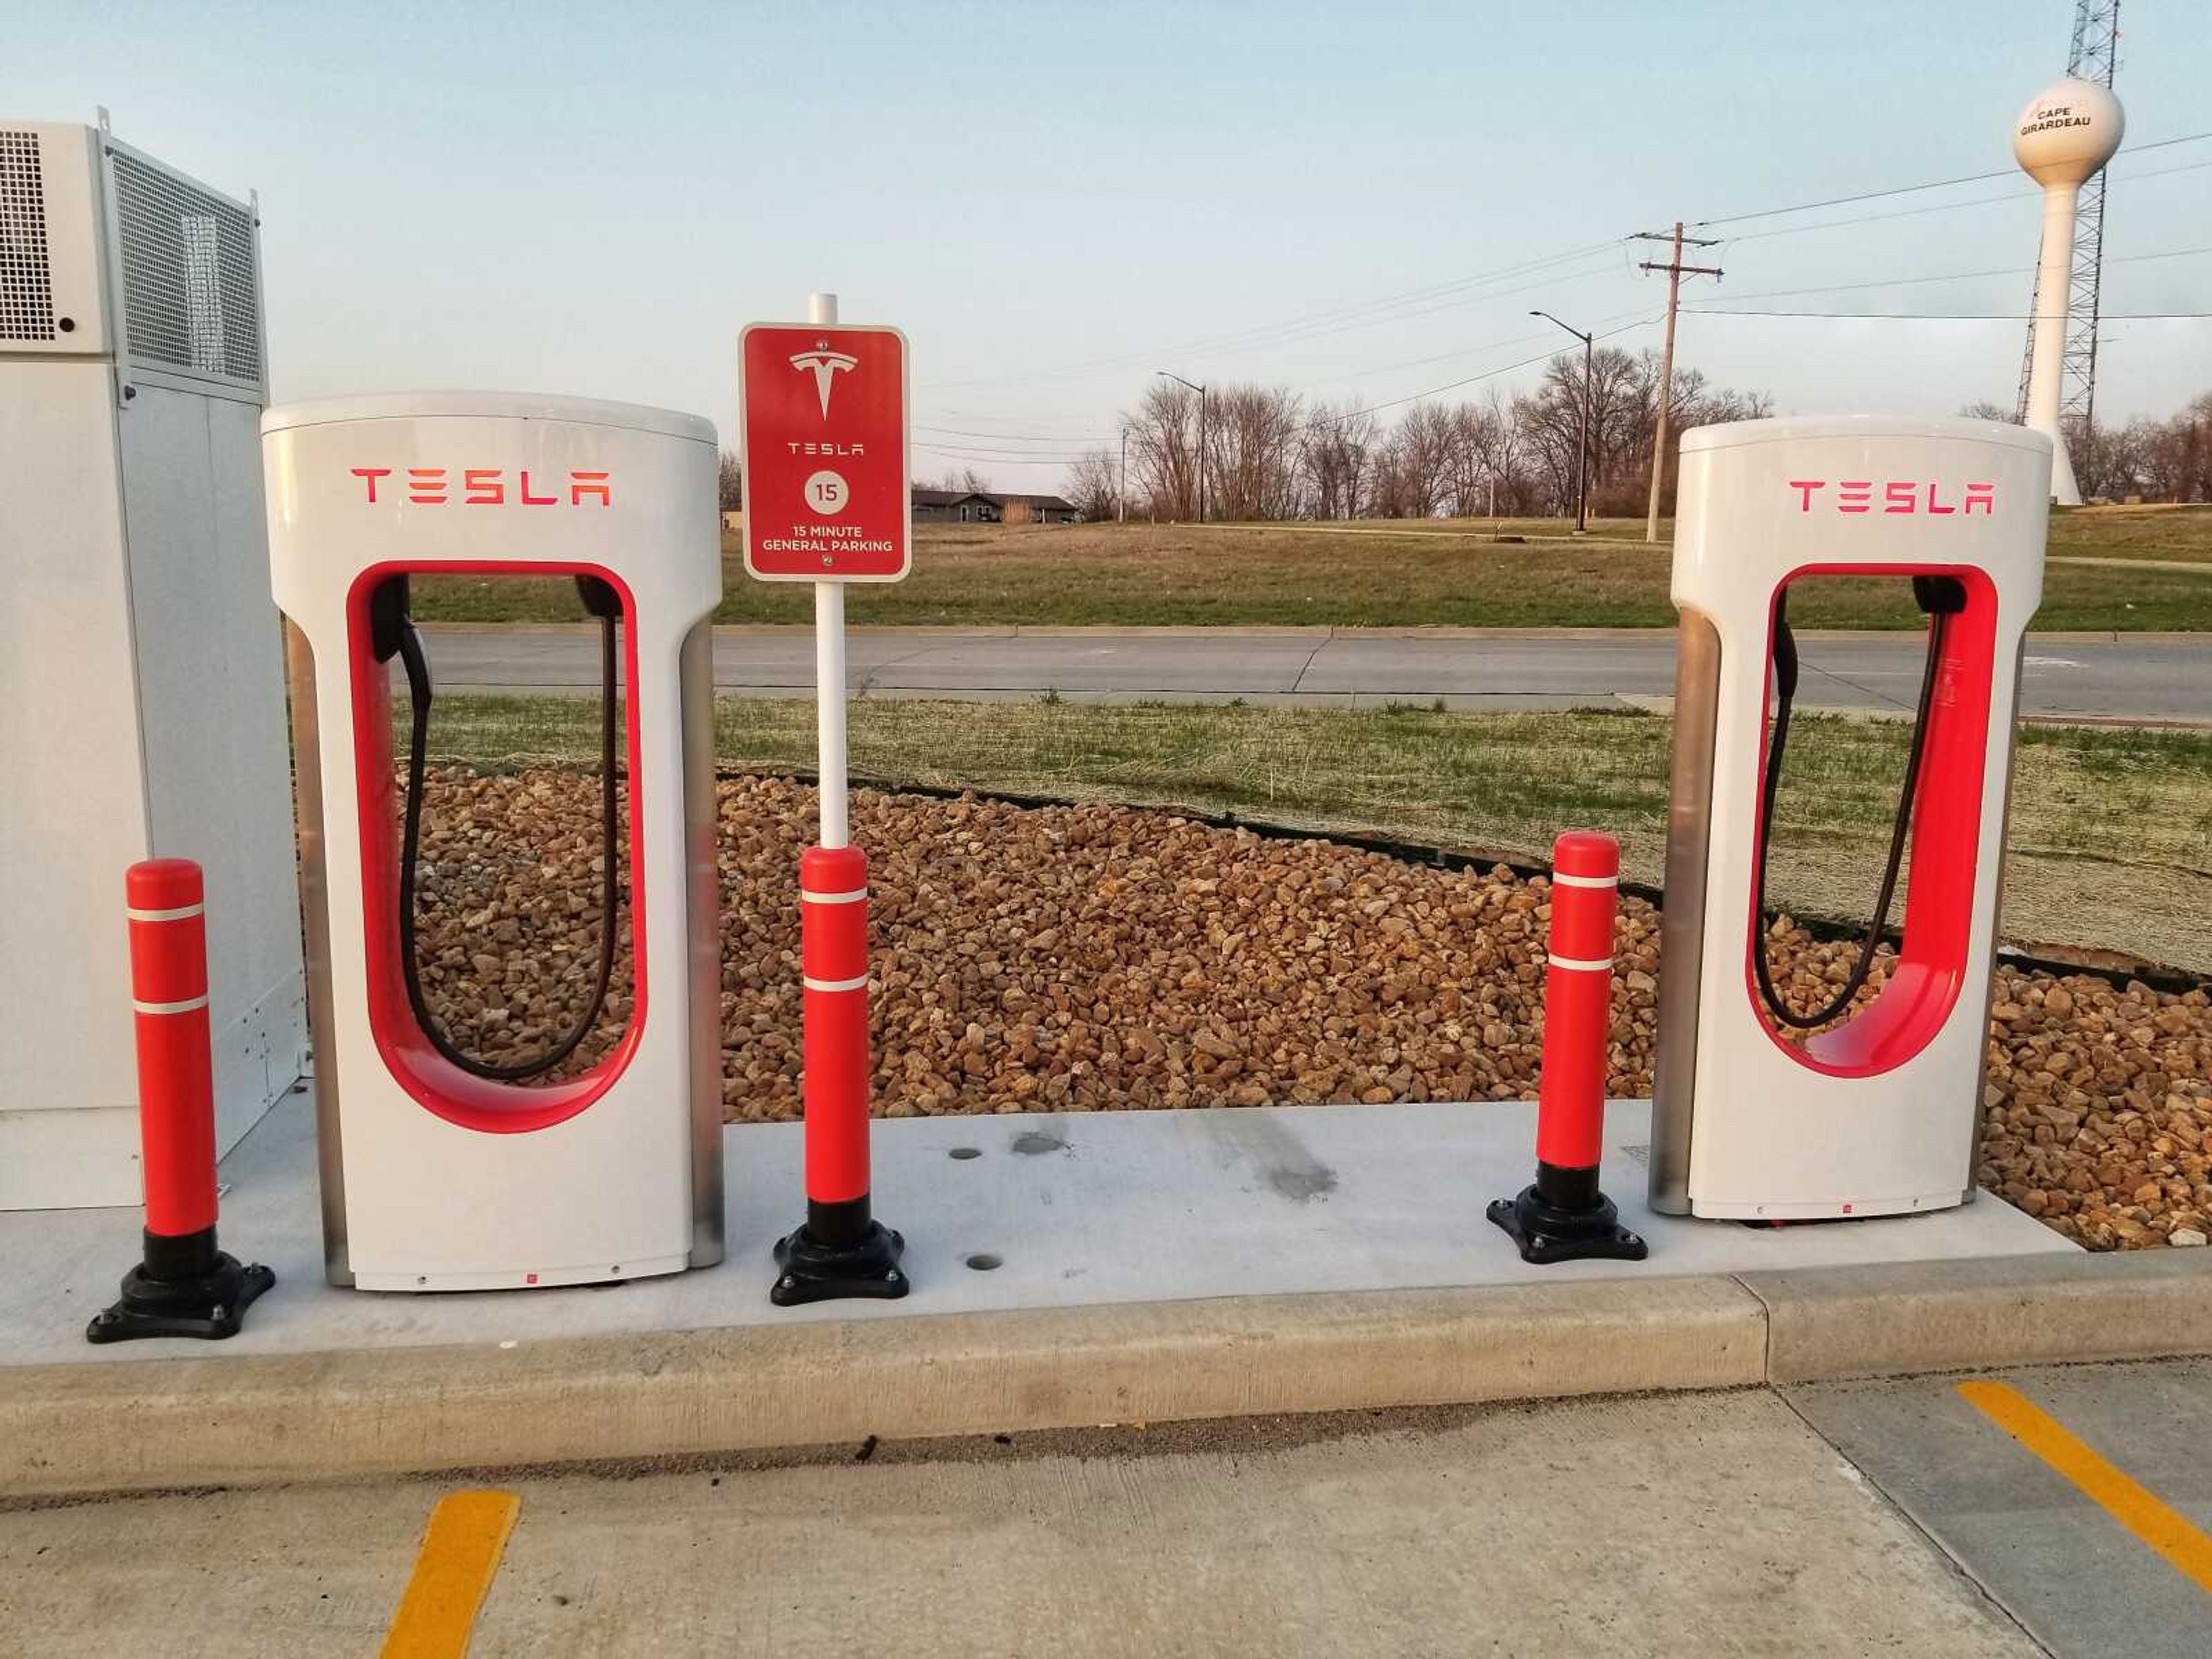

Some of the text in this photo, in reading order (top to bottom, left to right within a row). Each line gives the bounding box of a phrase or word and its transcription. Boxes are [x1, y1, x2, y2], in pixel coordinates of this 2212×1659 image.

[2037, 107, 2071, 120] CAPE
[2021, 117, 2091, 135] GIRARDEAU
[788, 442, 863, 455] TESLA
[351, 469, 609, 507] TESLA
[816, 484, 838, 502] 15
[1789, 482, 1994, 514] TESLA
[793, 526, 862, 537] 15 MINUTE
[763, 540, 893, 551] GENERAL PARKING
